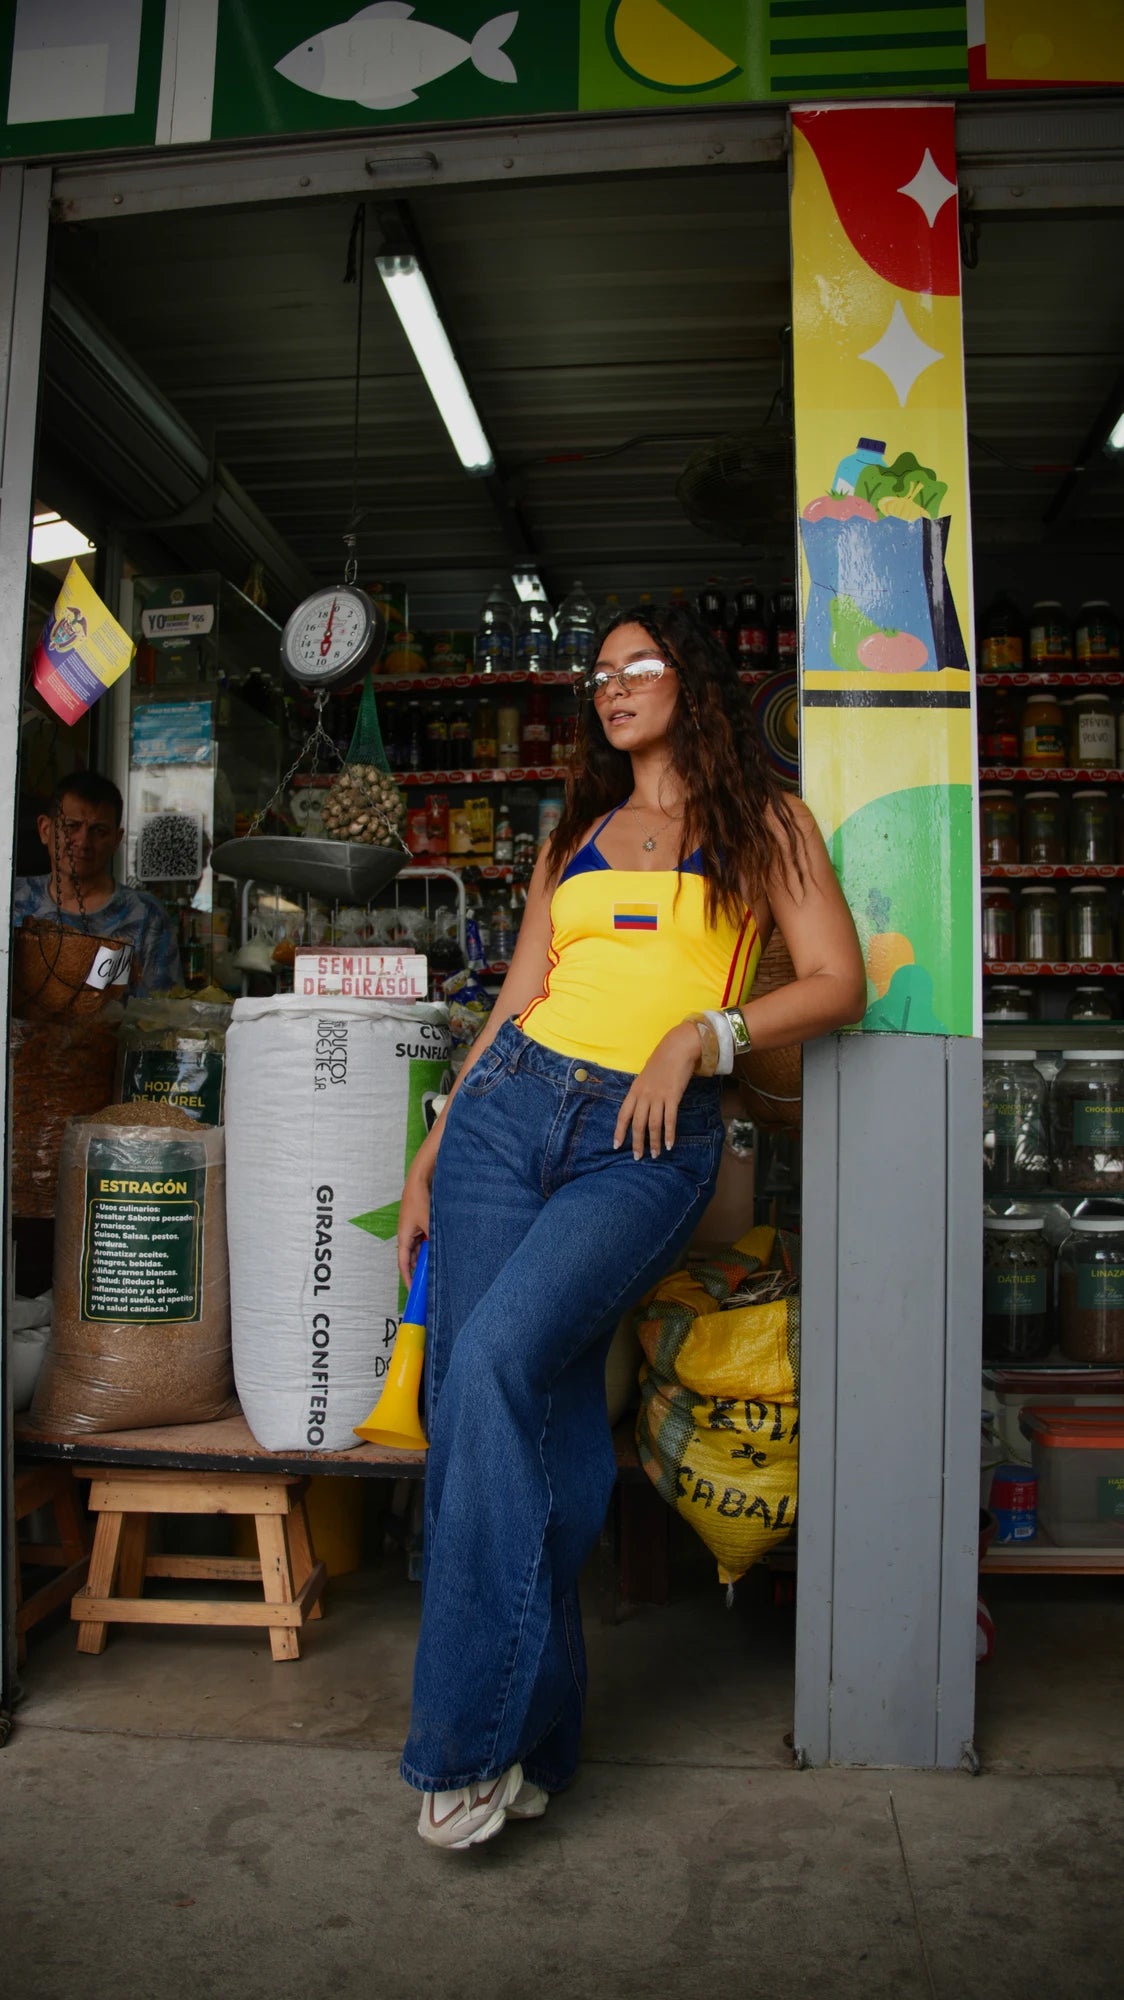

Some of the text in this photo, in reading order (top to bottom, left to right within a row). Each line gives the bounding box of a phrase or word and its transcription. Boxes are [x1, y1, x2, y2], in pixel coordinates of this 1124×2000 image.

[318, 611, 328, 619] 18
[301, 640, 311, 648] 14
[318, 957, 403, 975] SEMILLA
[303, 978, 422, 995] DE GIRASOL
[330, 1020, 348, 1085] DUCTOS
[395, 1043, 449, 1060] SUNFLO
[144, 1081, 189, 1093] HOJAS
[100, 1179, 187, 1195] ESTRAGÓN
[119, 1204, 161, 1213] culinarios:
[95, 1213, 126, 1221] Resaltar
[127, 1214, 160, 1222] Sabores
[100, 1222, 137, 1231] mariscos.
[122, 1232, 150, 1241] Salsas,
[314, 1184, 334, 1297] GIRASOL
[94, 1239, 129, 1249] verduras.
[94, 1249, 137, 1258] Aromatizar
[129, 1260, 164, 1268] bebidas.
[92, 1266, 178, 1277] Aliñar carnes blancas.
[96, 1276, 121, 1285] Salud:
[122, 1278, 155, 1286] (Reduce
[92, 1284, 138, 1294] inflamación
[139, 1288, 145, 1296] y
[146, 1287, 155, 1295] el
[91, 1294, 119, 1304] mejora
[119, 1295, 128, 1303] el
[157, 1296, 166, 1304] el
[166, 1294, 194, 1304] apetito
[90, 1303, 96, 1312] y
[97, 1303, 105, 1311] la
[106, 1304, 129, 1312] salud
[674, 1466, 798, 1531] CABAL
